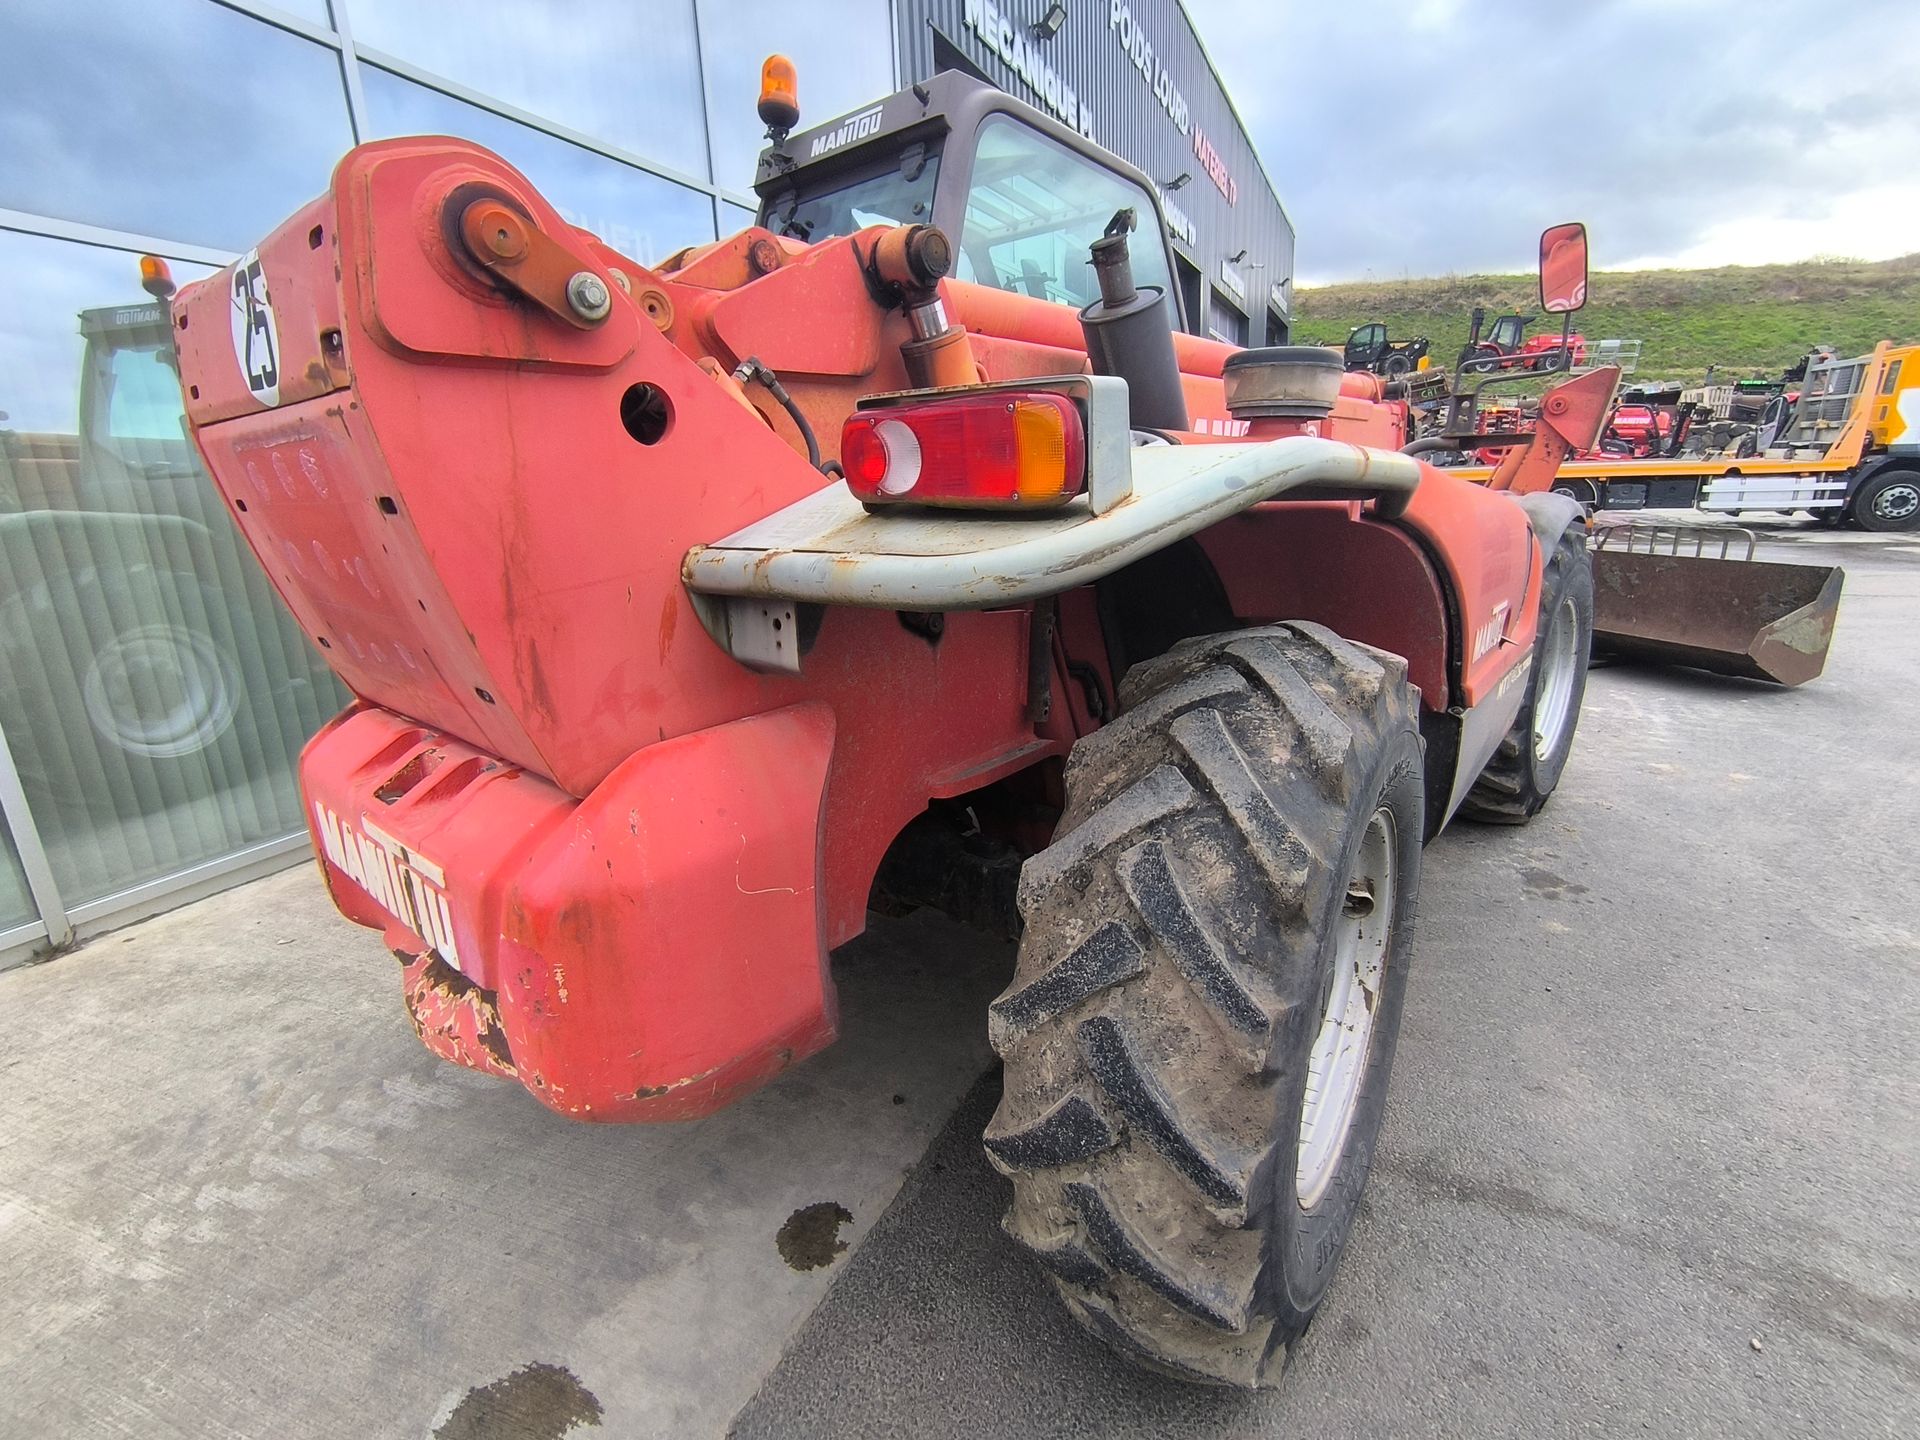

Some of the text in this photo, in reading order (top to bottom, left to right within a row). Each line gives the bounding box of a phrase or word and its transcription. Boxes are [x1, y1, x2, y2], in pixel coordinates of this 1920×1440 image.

[811, 105, 884, 158] MANITOU
[1109, 0, 1152, 83] POIDS
[1153, 57, 1189, 136] LOURD
[235, 260, 278, 391] 25
[314, 800, 462, 972] MANITOU
